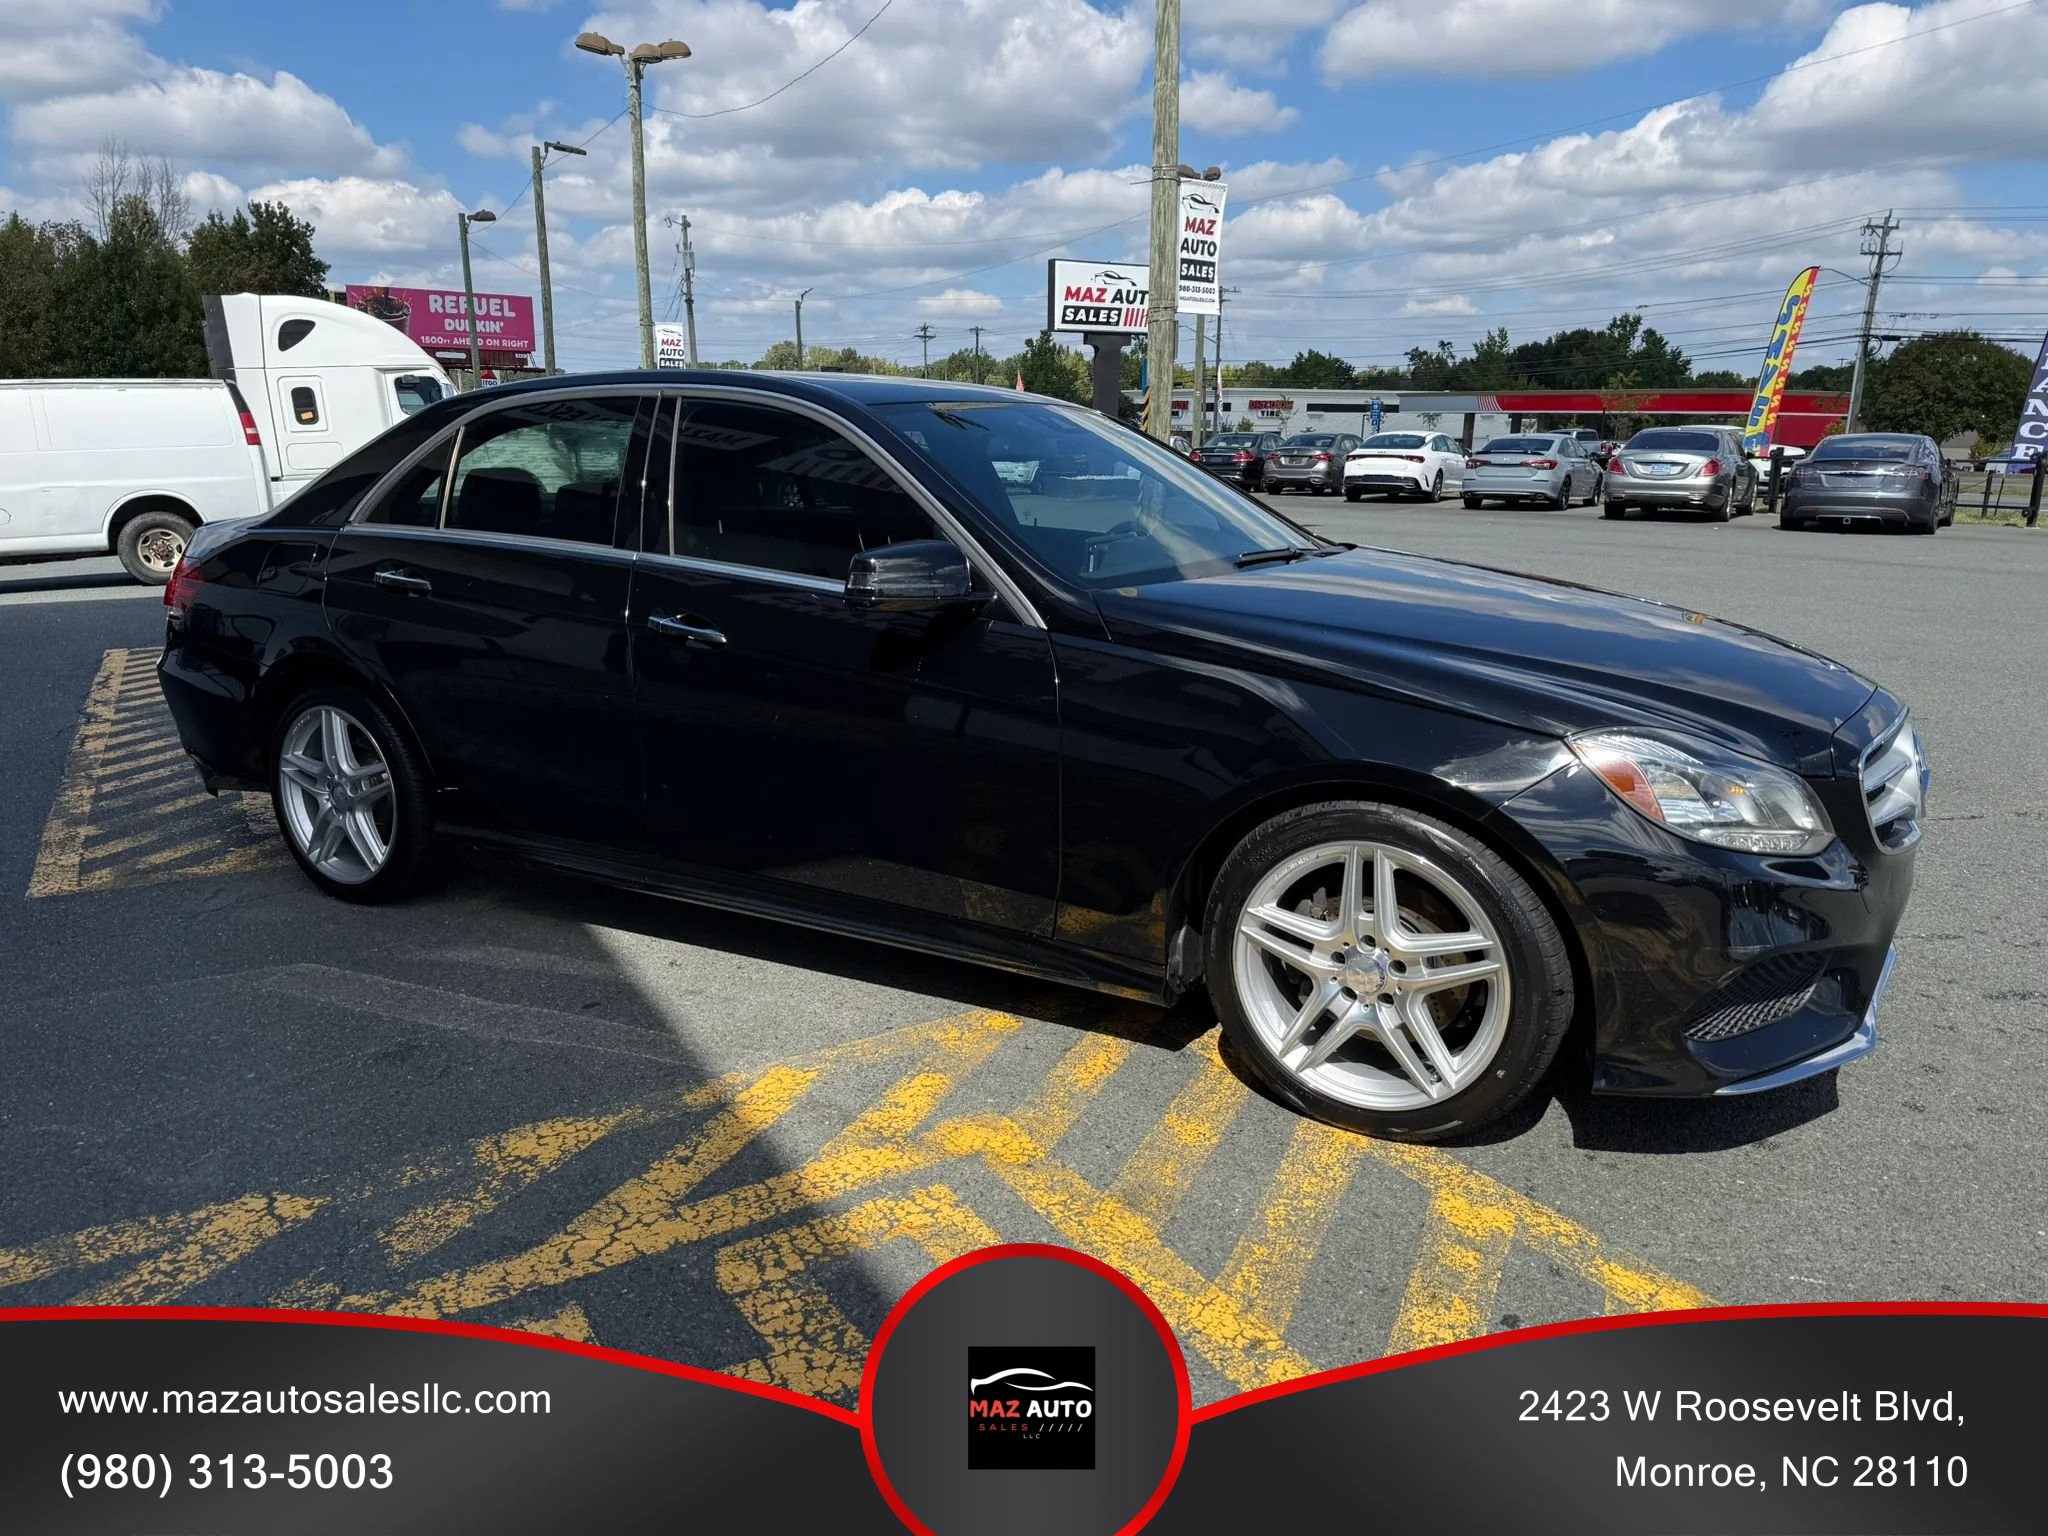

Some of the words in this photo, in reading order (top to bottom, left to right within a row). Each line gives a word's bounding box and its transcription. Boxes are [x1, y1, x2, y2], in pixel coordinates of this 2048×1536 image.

[1184, 216, 1217, 236] MAZ
[1180, 237, 1218, 257] AUTO
[1181, 263, 1214, 279] SALES
[1064, 285, 1108, 303] MAZ
[1110, 288, 1149, 305] AUT
[428, 294, 516, 318] REFUEL
[1064, 308, 1119, 323] SALES
[452, 336, 483, 346] AHED
[486, 337, 500, 347] ON
[502, 338, 529, 349] RIGHT
[661, 338, 682, 347] MAZ
[659, 348, 685, 357] AUTO
